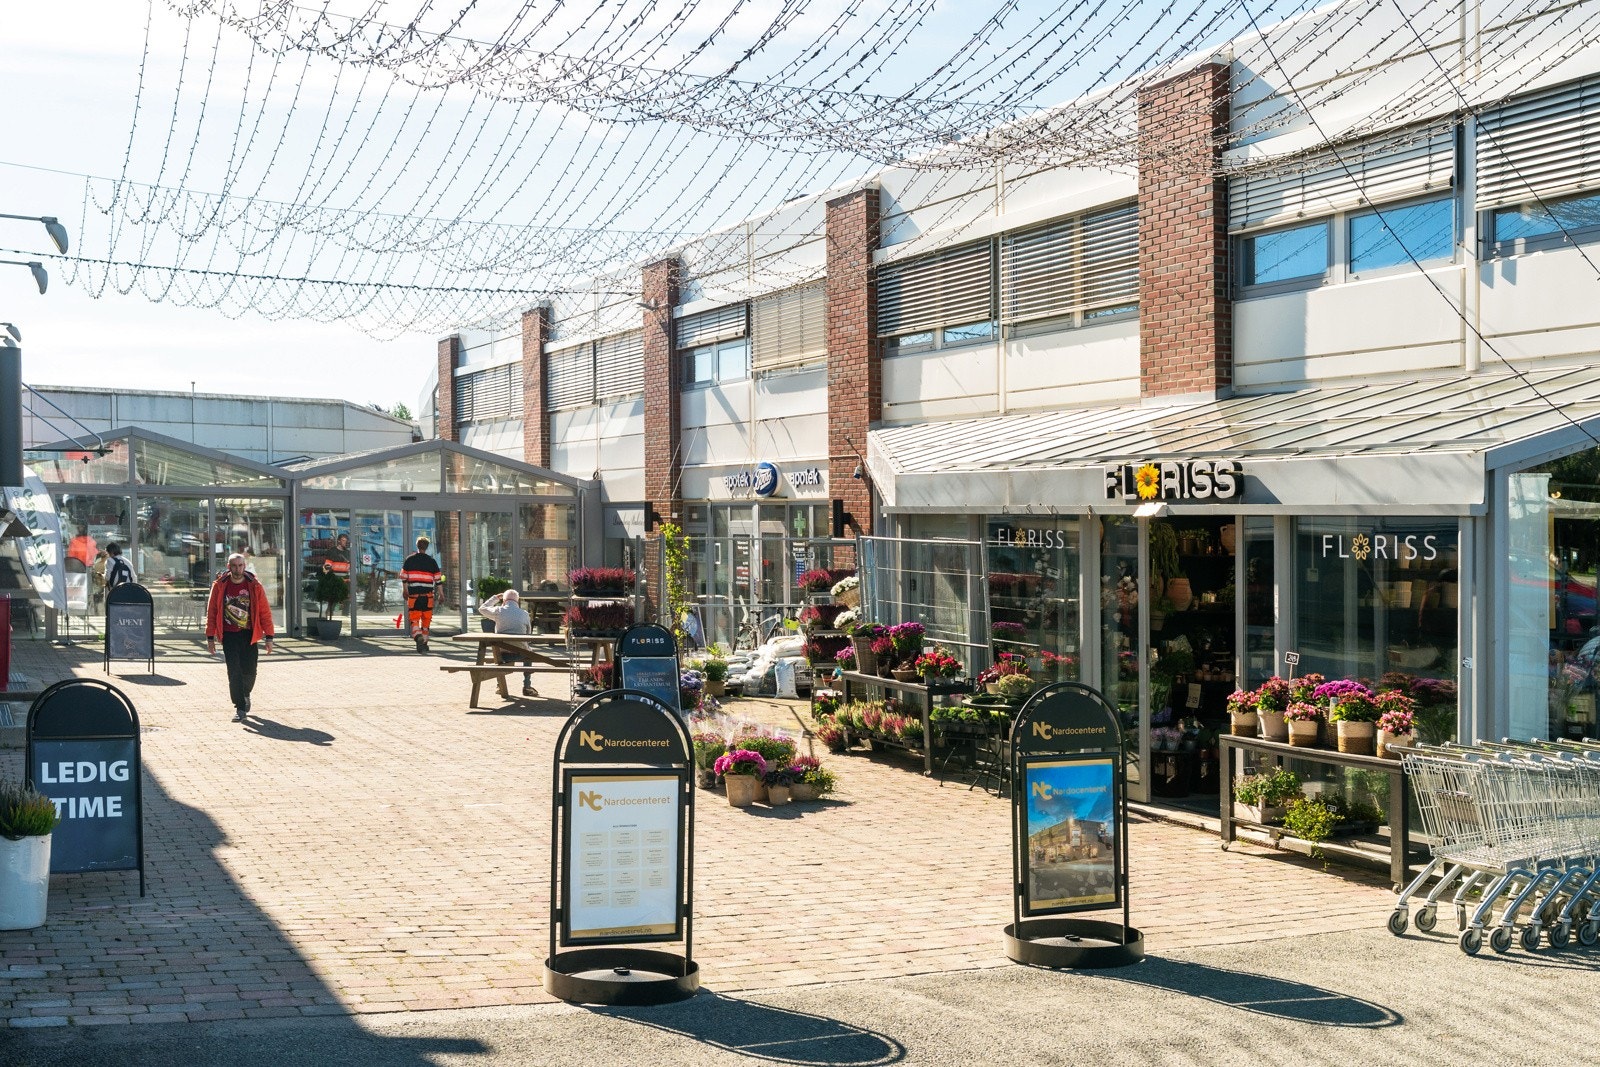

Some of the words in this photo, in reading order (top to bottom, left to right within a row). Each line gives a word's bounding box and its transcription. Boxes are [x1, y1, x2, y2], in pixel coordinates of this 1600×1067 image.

[724, 471, 751, 490] apotek
[790, 467, 819, 488] apotek
[1103, 459, 1237, 500] FLORISS
[997, 527, 1064, 549] FLORISS
[1322, 532, 1437, 561] FLORISS
[631, 637, 665, 645] FLORISS
[579, 730, 604, 752] NC
[604, 738, 670, 748] Nardocenteret
[1032, 721, 1052, 740] NC
[1052, 725, 1106, 736] Nardocenteret
[41, 760, 130, 783] LEDIG
[578, 790, 603, 812] NC
[604, 795, 671, 806] Nardocenteret
[1031, 780, 1052, 800] NC
[1053, 784, 1107, 796] Nardocenteret
[49, 795, 122, 819] TIME
